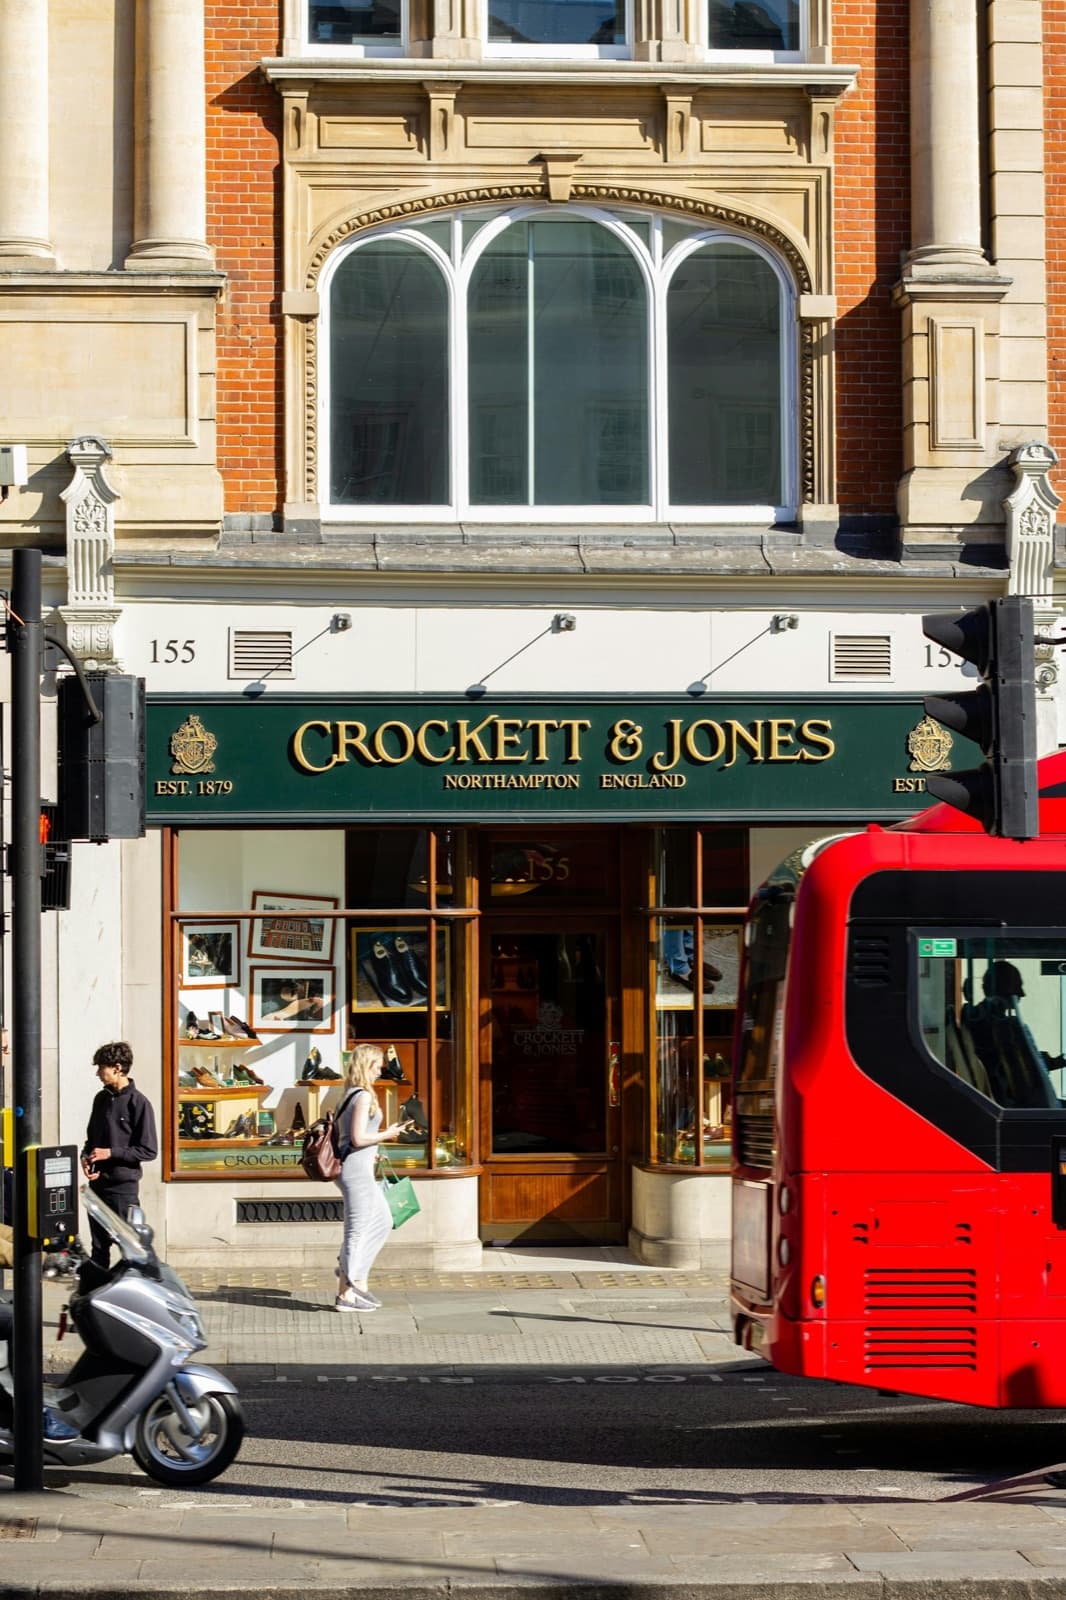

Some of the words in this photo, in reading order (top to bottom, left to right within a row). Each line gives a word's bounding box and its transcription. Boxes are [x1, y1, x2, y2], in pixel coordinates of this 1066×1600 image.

[150, 639, 195, 664] 155
[924, 644, 967, 668] 15
[293, 714, 591, 772] CROCKETT
[611, 719, 643, 761] &
[652, 719, 835, 770] JONES
[156, 780, 193, 796] EST.
[198, 780, 233, 796] 1879
[445, 774, 580, 790] NORTHAMPTON
[602, 774, 686, 788] ENGLAND
[527, 857, 570, 881] 155
[513, 1031, 584, 1045] CROCKETT
[536, 1044, 577, 1056] JONES
[224, 1154, 303, 1168] CROCKET
[261, 1375, 475, 1384] RIGHT
[544, 1374, 723, 1383] LOOK
